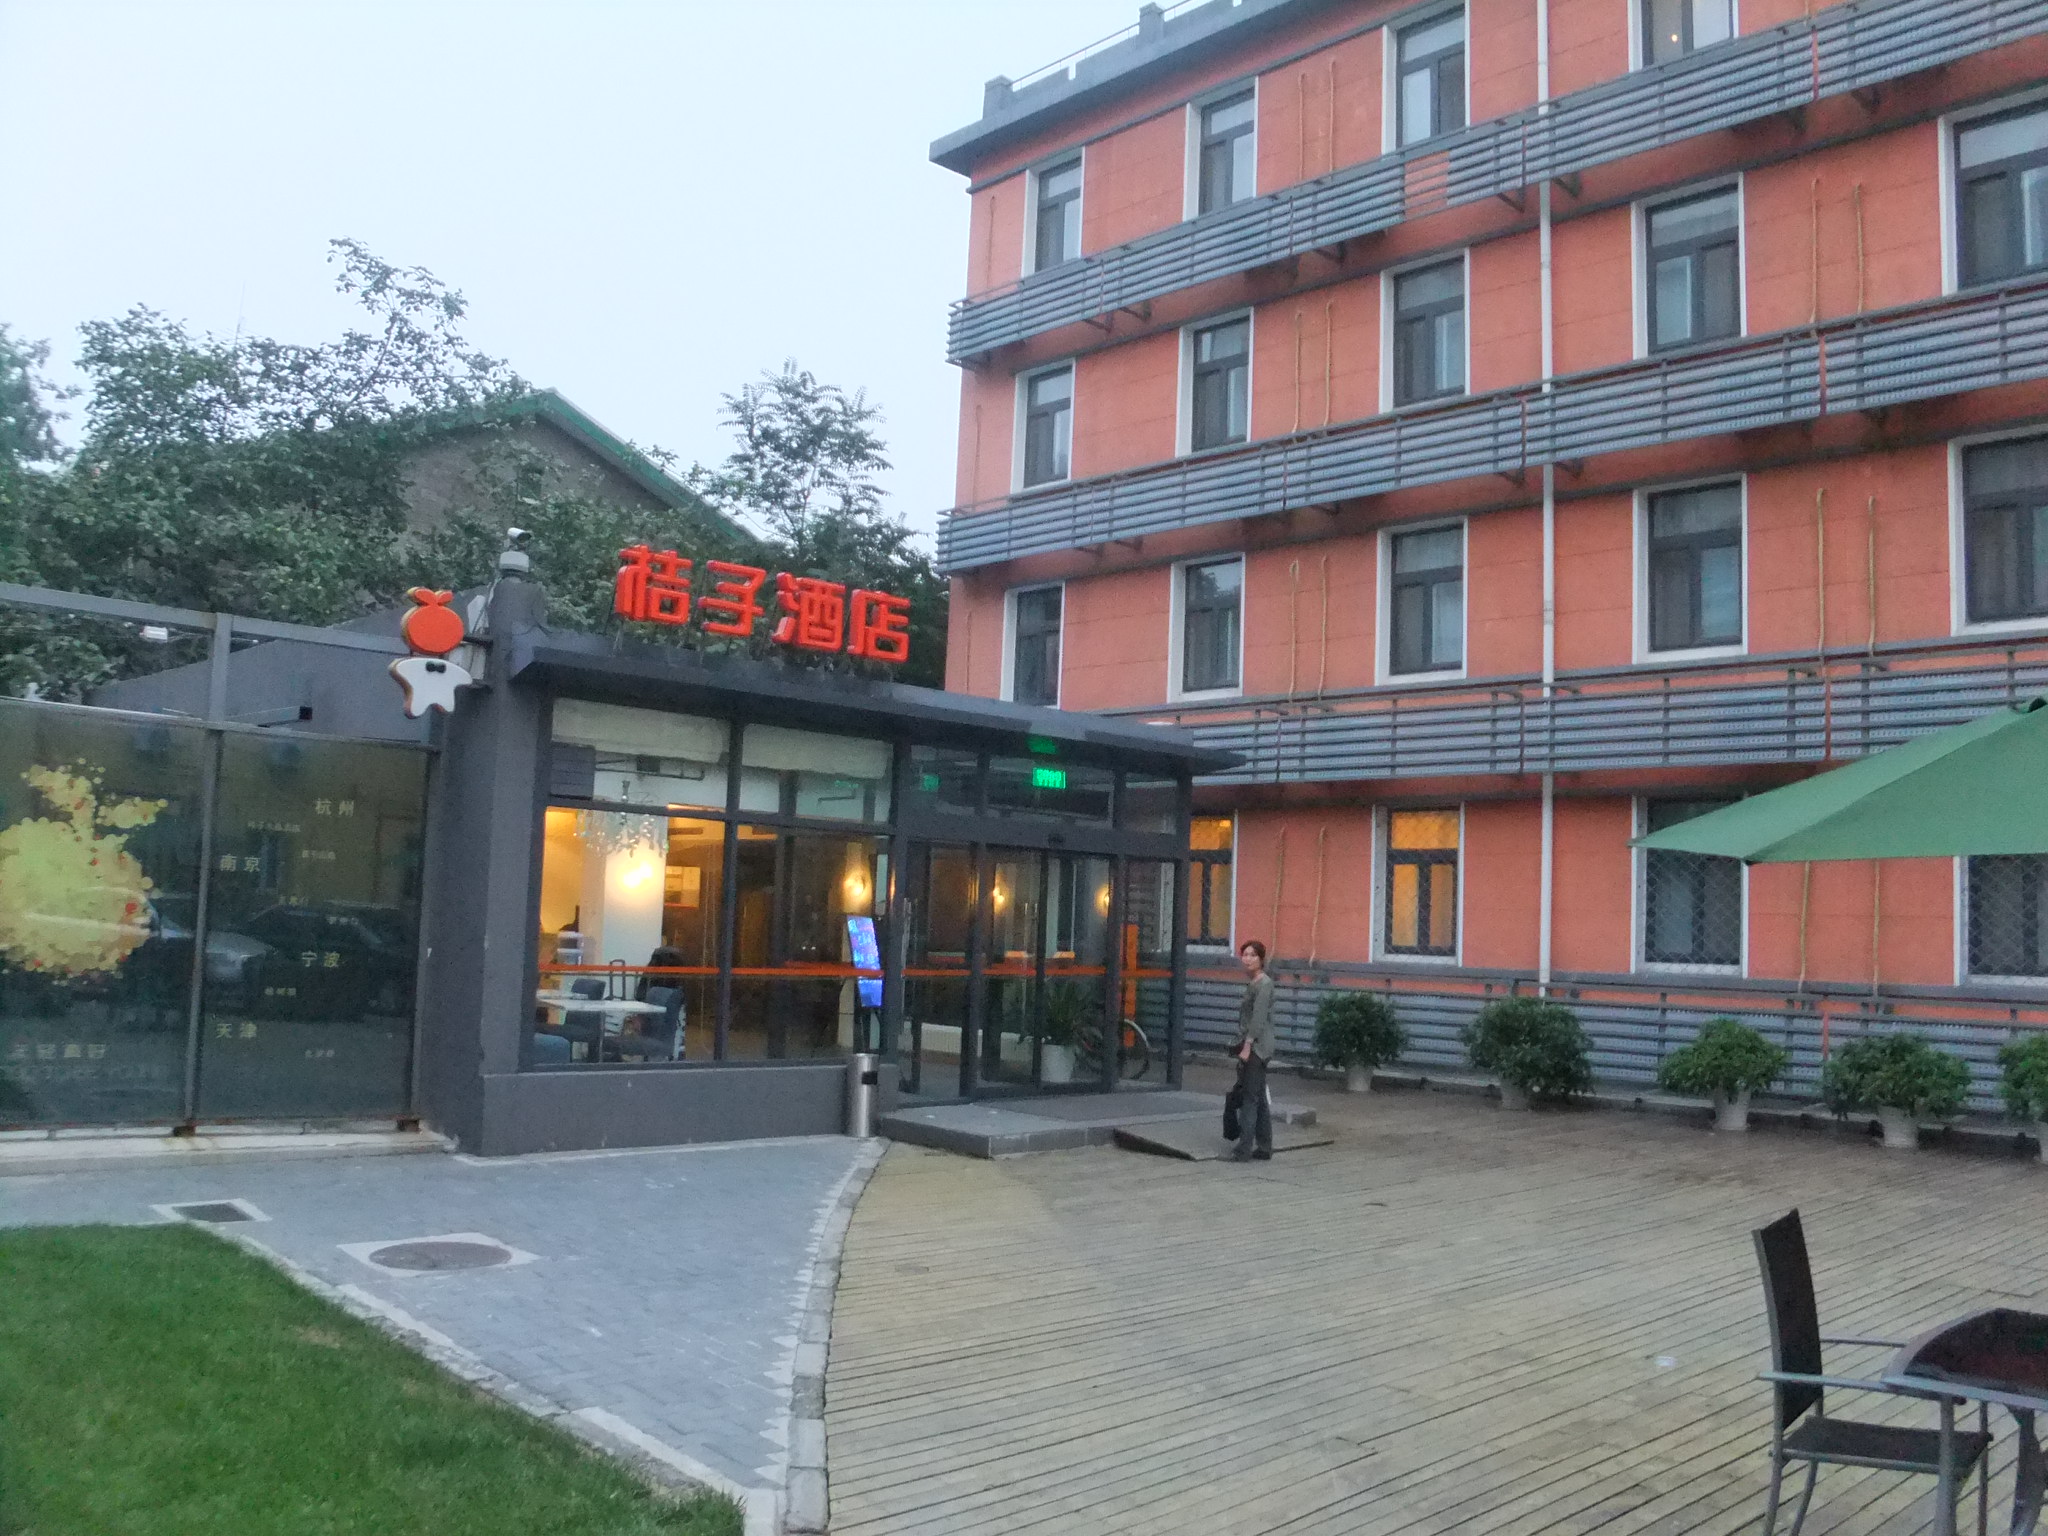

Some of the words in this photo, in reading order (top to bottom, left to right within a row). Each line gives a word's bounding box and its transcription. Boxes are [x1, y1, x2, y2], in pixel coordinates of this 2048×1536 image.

[615, 545, 910, 662] 桔子酒店
[315, 797, 355, 817] 杭州
[220, 853, 261, 873] 南京
[301, 950, 341, 968] 宁波
[215, 1021, 257, 1039] 天津
